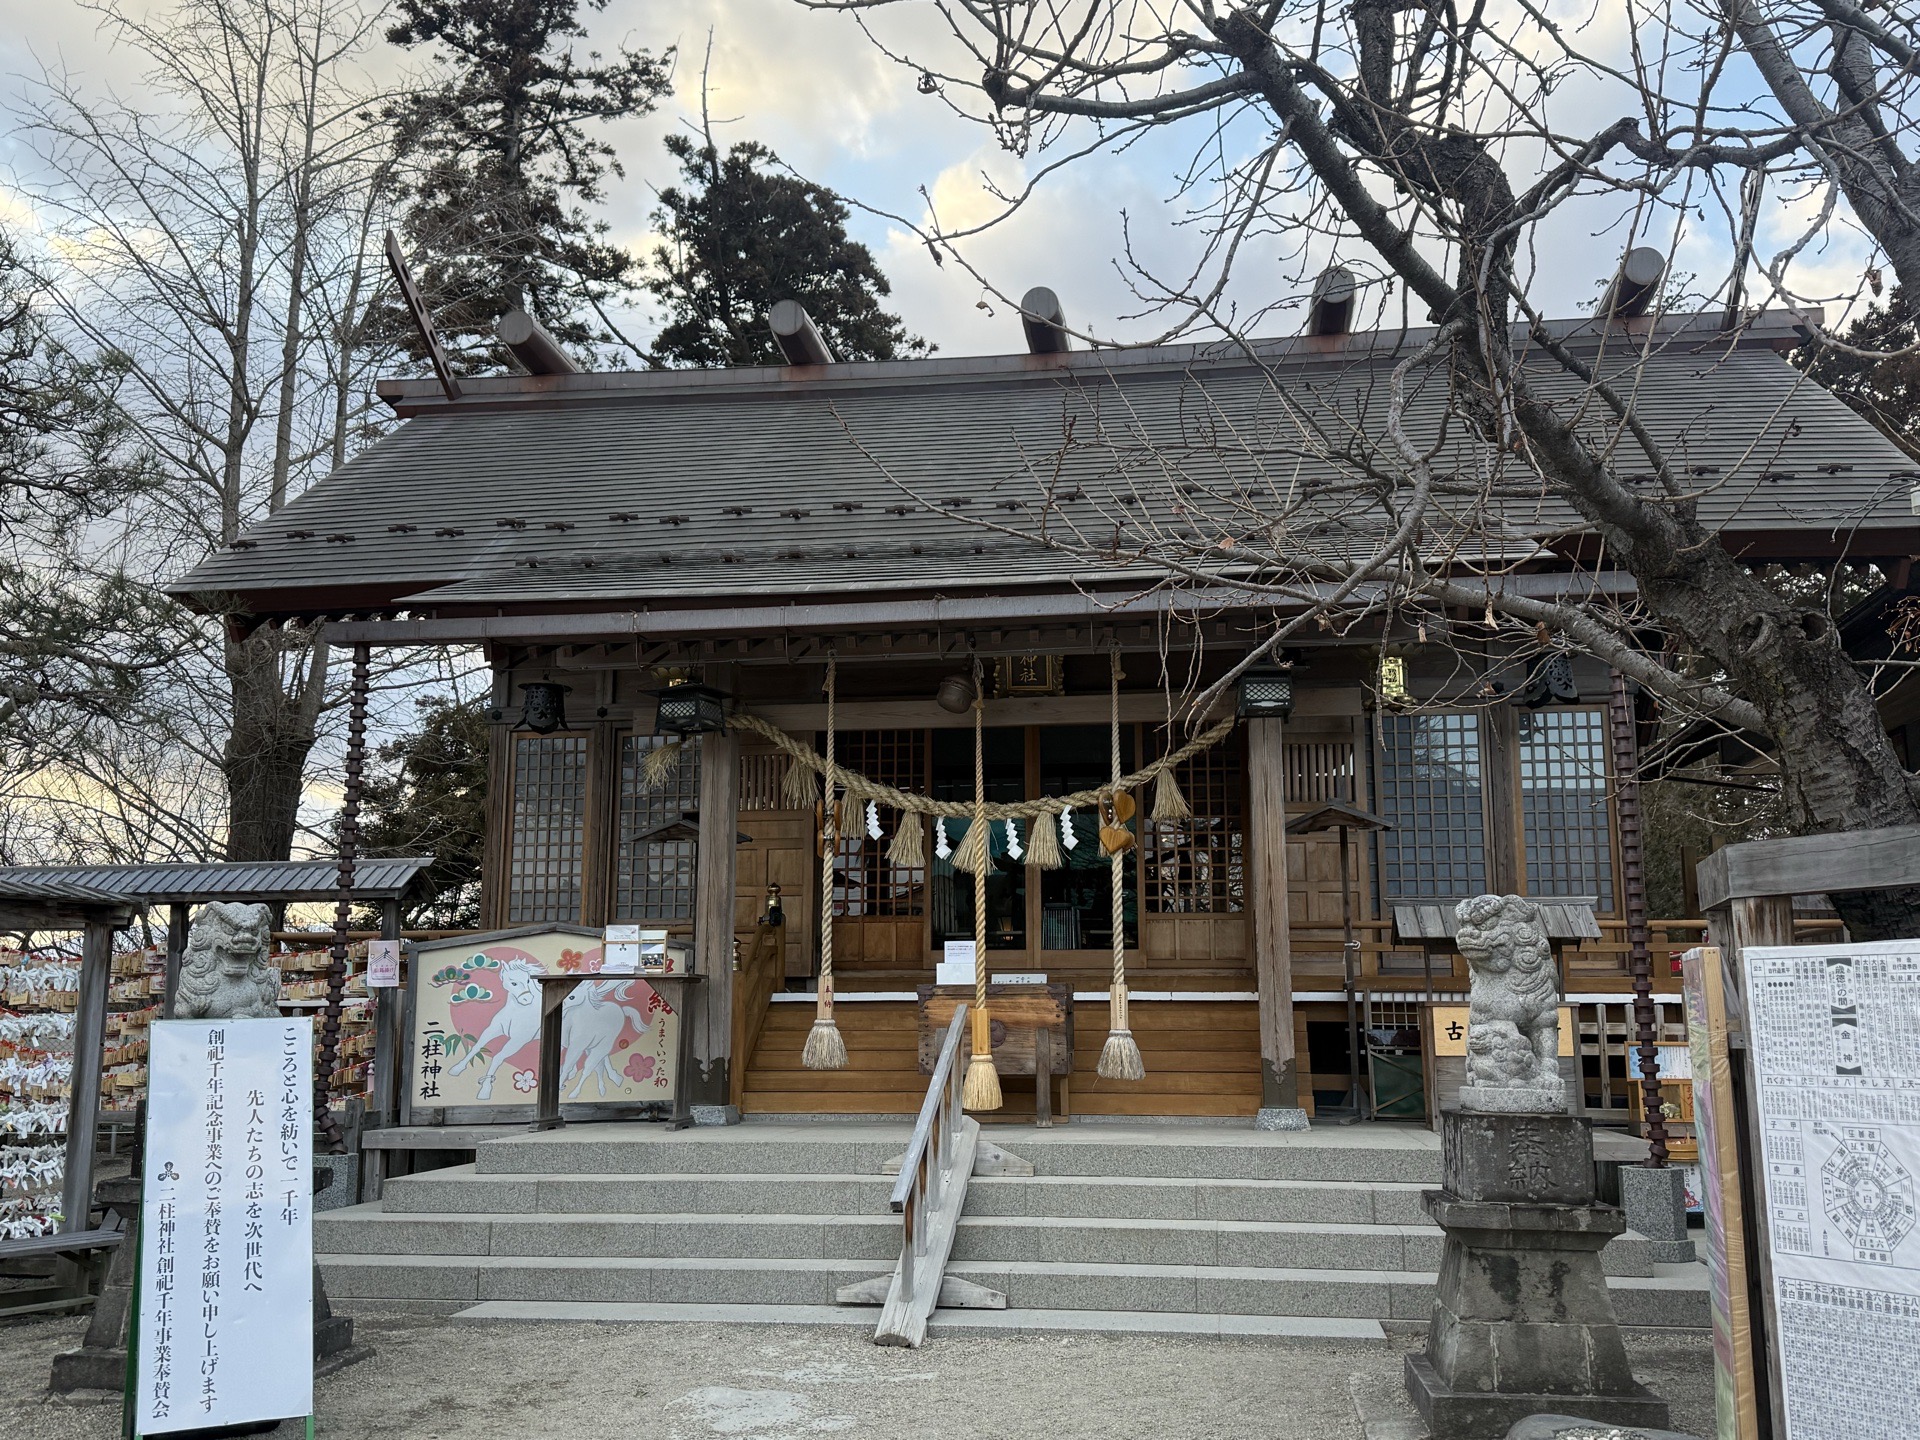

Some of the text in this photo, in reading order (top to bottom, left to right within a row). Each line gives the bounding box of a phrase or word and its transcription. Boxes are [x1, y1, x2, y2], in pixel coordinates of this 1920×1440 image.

[1020, 656, 1037, 682] 神社
[279, 1027, 299, 1227] こころと心を紡いで一千年
[420, 1021, 444, 1100] 二柱神社
[1509, 1127, 1559, 1191] 奉納
[199, 1029, 226, 1414] 創祀千年記念事業へのご奉賛をお願い申し上げます
[243, 1089, 265, 1295] 先人たちの志を次世代へ
[151, 1187, 177, 1419] 二柱神社創祀千年事業奉賛会
